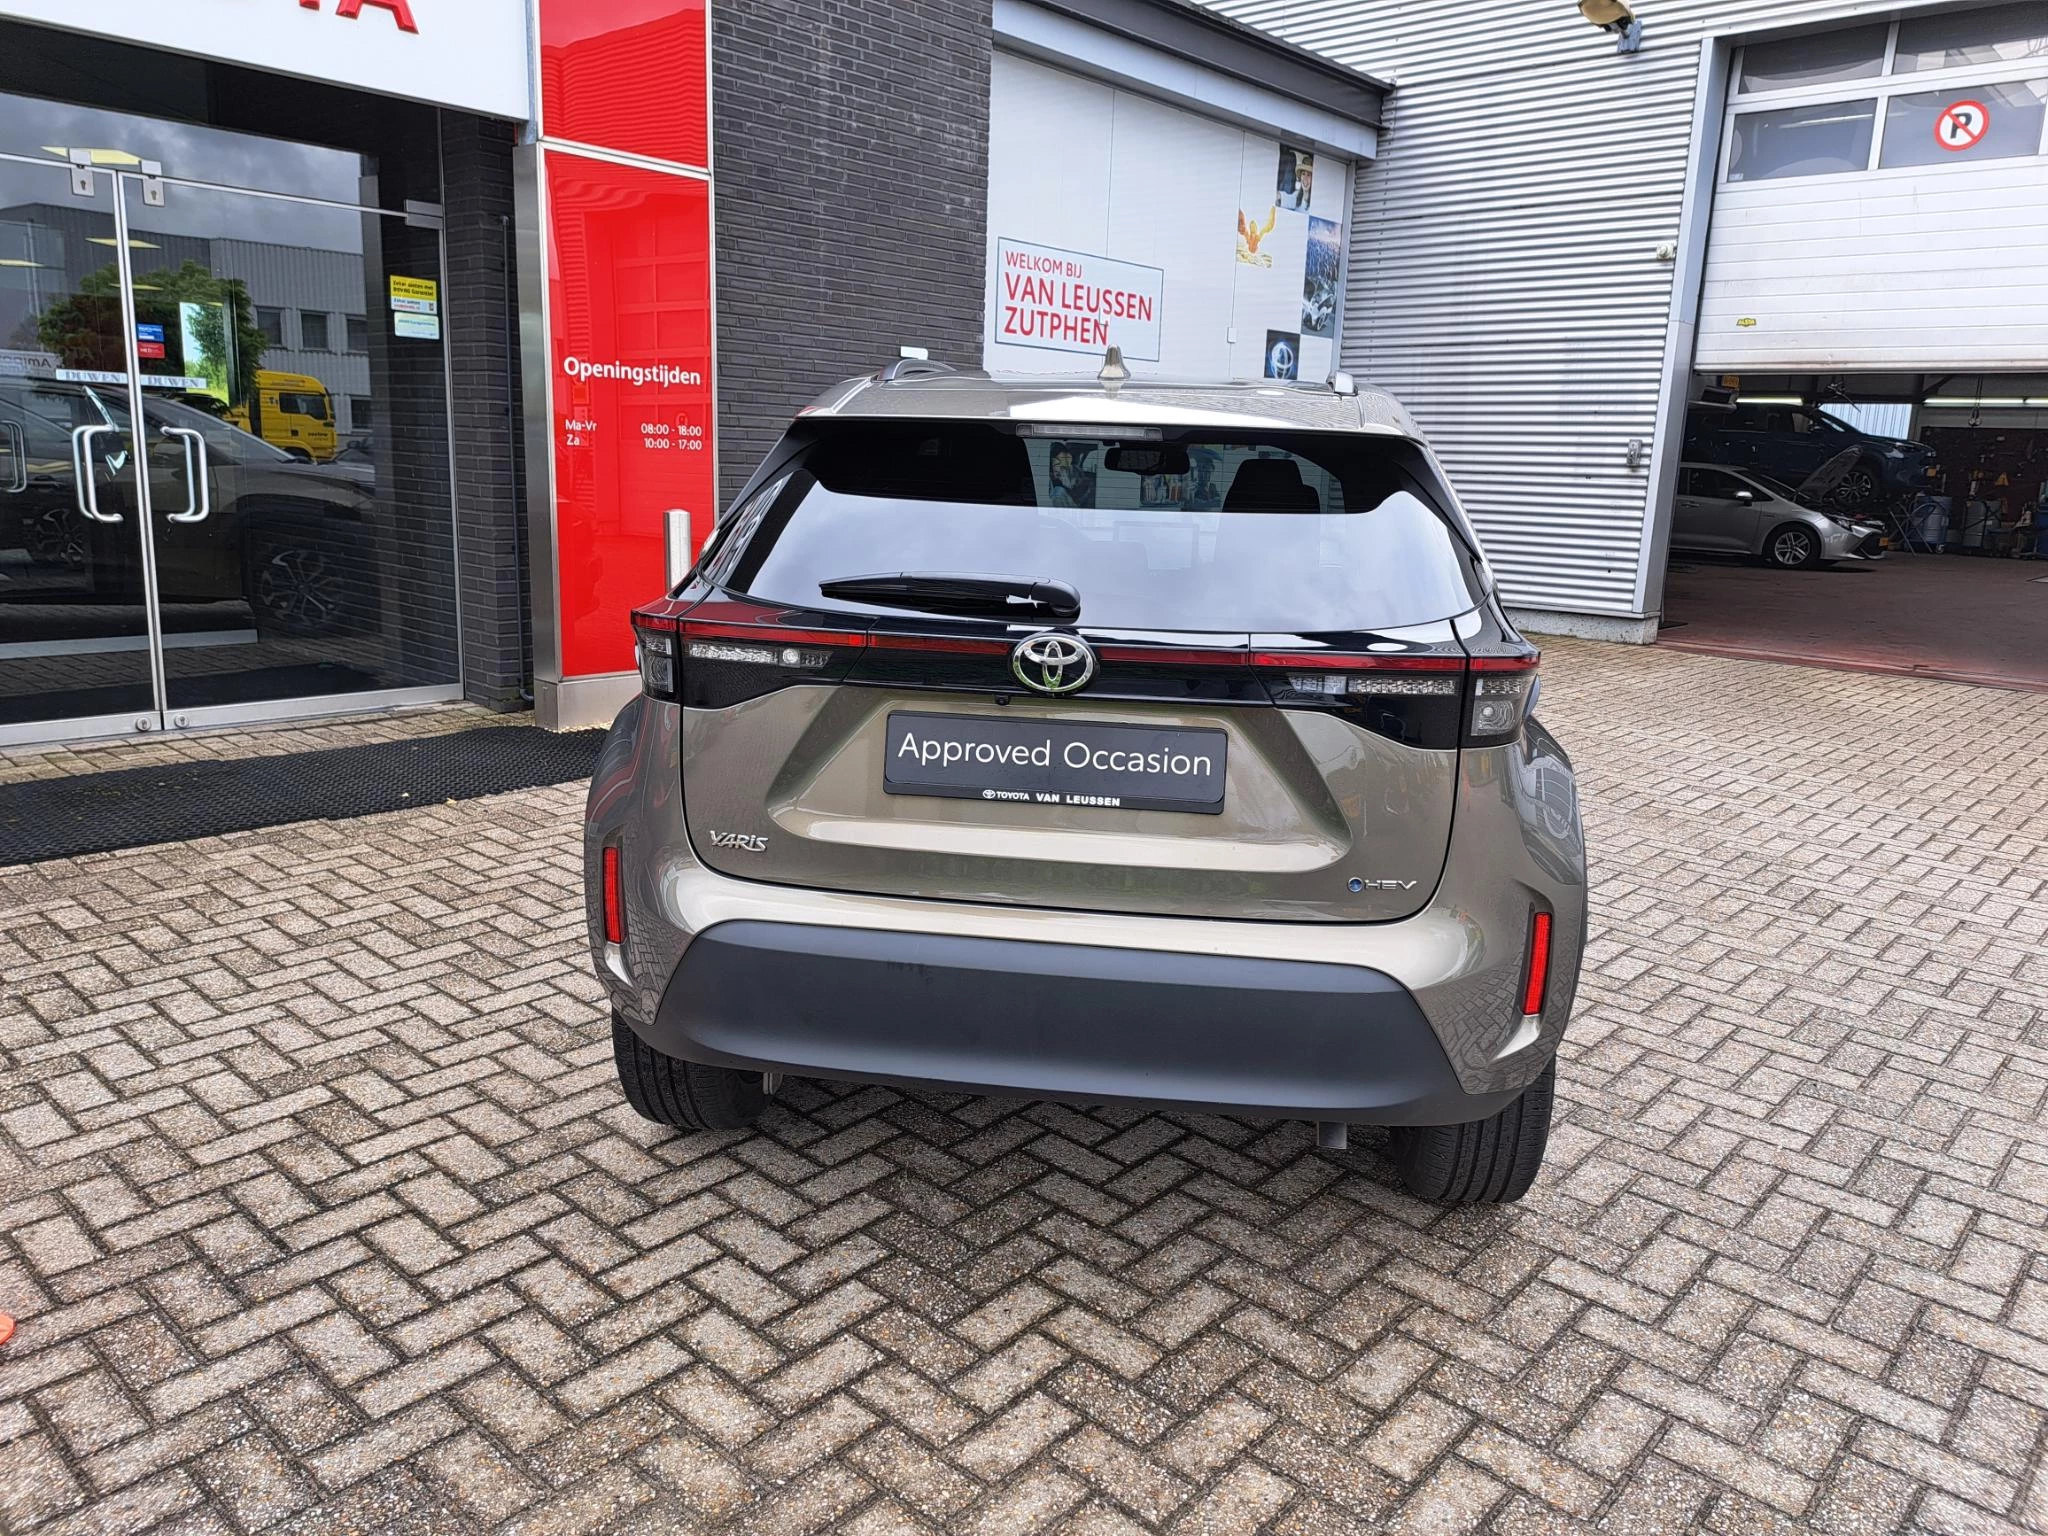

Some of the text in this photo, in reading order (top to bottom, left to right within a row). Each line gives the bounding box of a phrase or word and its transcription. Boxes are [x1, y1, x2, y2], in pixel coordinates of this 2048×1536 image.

[1005, 250, 1083, 279] WELKOM BIJ
[1004, 271, 1153, 322] VAN LEUSSEN
[1003, 305, 1110, 346] ZUTPHEN
[65, 371, 121, 383] DUWEN
[147, 375, 199, 388] DUWEN
[563, 356, 701, 388] Openingstijden
[565, 419, 598, 432] Ma-Vr
[640, 423, 669, 435] 08:00
[677, 425, 703, 437] 18:00
[566, 434, 581, 446] Za
[643, 438, 670, 450] 10:00
[678, 439, 703, 451] 17:00
[897, 732, 1211, 777] Approved Occasion
[996, 791, 1121, 807] TOYOTA VAN LEUSSEN
[709, 830, 769, 853] YARIS
[1364, 879, 1418, 890] HEV
